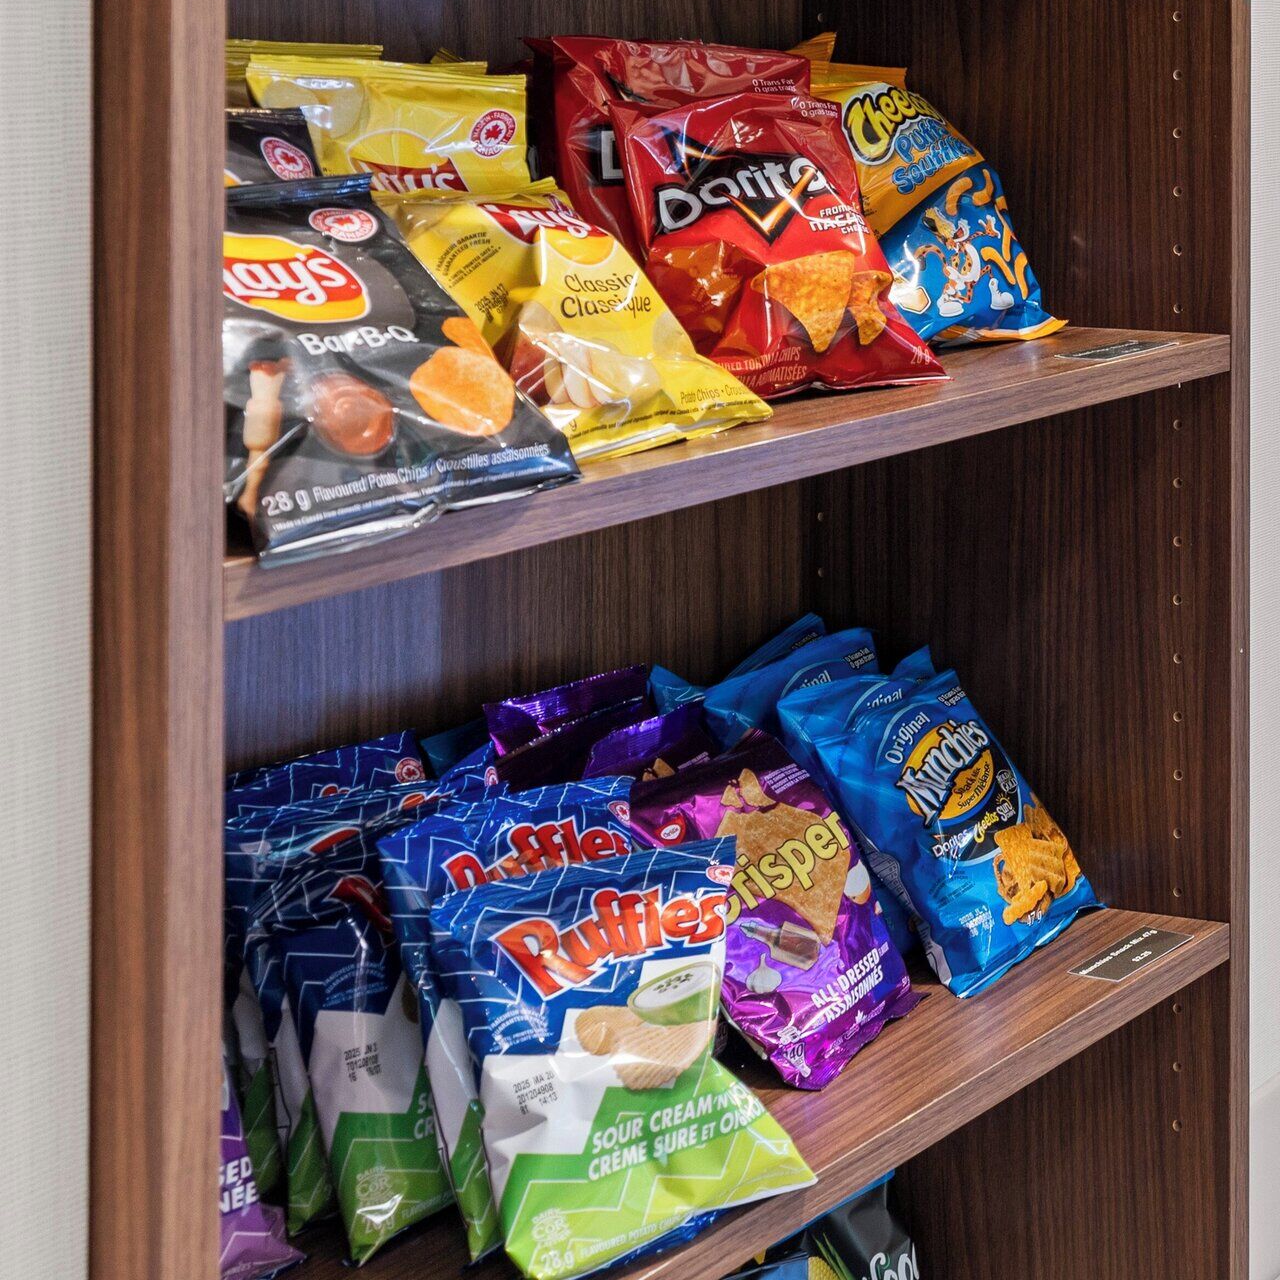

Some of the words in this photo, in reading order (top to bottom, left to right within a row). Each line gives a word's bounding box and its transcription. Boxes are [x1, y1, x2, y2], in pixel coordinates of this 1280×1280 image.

[807, 101, 825, 111] Trans
[808, 110, 823, 118] gras
[564, 272, 639, 294] Classic
[560, 294, 652, 320] Classique
[697, 386, 721, 401] Chips
[262, 489, 293, 516] 28
[294, 488, 312, 511] g
[312, 475, 367, 504] Flavoured
[367, 473, 399, 491] Potato
[398, 467, 429, 486] Chips
[435, 454, 490, 472] Croustilles
[490, 442, 550, 465] assaisonnées
[884, 711, 931, 765] Original
[896, 719, 991, 828] Munchies
[952, 774, 976, 800] Snack
[957, 792, 978, 811] Super
[973, 811, 1000, 843] Cheetos
[492, 890, 729, 1002] Ruffles
[1079, 955, 1113, 976] Munchies
[1110, 944, 1133, 957] Snack
[810, 982, 839, 1008] ALL
[839, 947, 882, 988] DRESSED
[824, 965, 885, 1024] ASSAISONNÉS
[512, 1081, 532, 1093] 2025
[591, 1116, 644, 1155] SOUR
[648, 1096, 714, 1133] CREAM
[588, 1142, 648, 1182] CRÈME
[652, 1127, 699, 1160] SURE
[700, 1123, 716, 1141] ET
